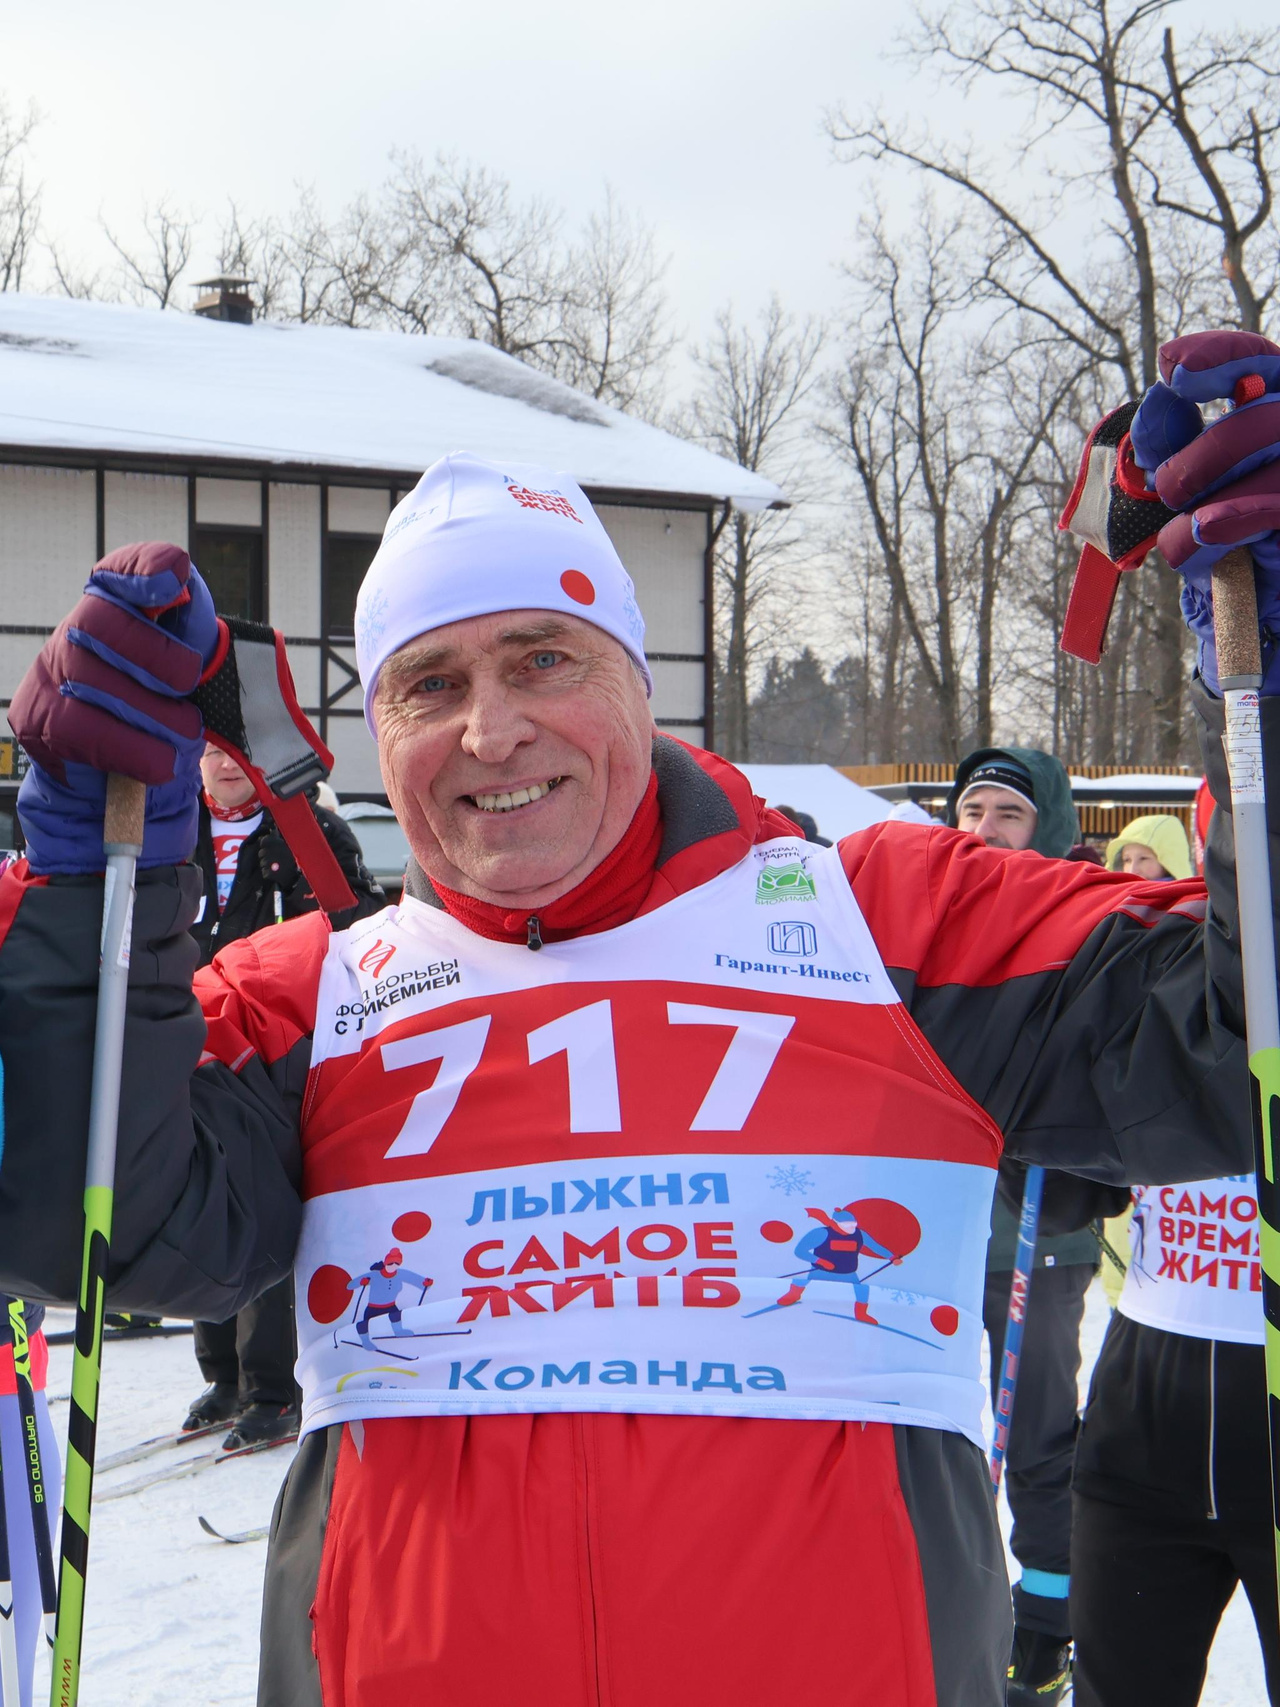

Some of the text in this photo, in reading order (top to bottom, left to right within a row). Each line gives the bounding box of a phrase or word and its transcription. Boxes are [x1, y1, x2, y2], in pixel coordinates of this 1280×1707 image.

[375, 958, 458, 996] БОРЬБЫ
[713, 953, 872, 984] Гарант-Инвест
[379, 998, 797, 1160] 717
[464, 1172, 731, 1228] ЛЫЖНЯ
[1159, 1186, 1259, 1223] САМО
[461, 1221, 739, 1278] САМОЕ
[1158, 1216, 1261, 1257] ВРЕМ
[448, 1358, 788, 1395] Команда
[25, 1415, 44, 1504] DIAMOND 06
